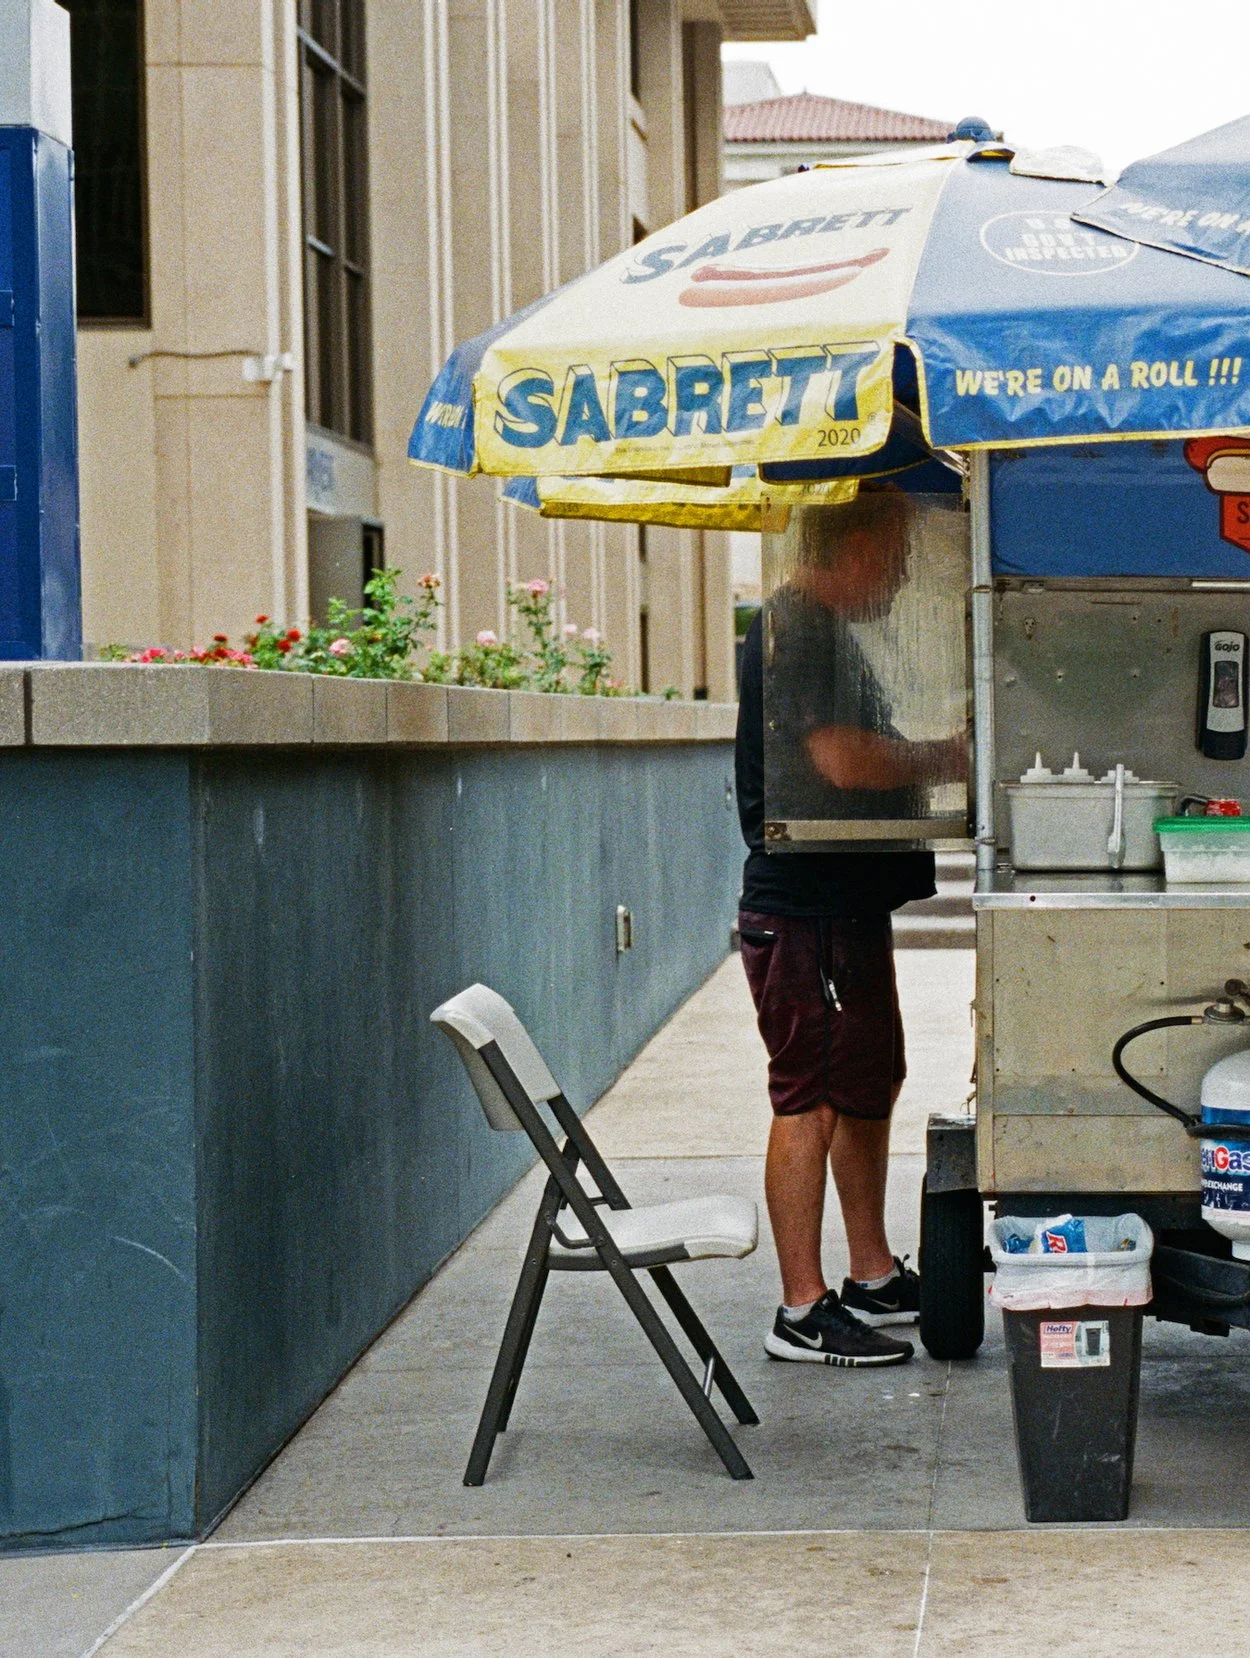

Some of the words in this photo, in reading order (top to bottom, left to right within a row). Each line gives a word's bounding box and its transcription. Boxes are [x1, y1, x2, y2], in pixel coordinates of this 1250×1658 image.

[1198, 212, 1240, 229] ON
[619, 206, 913, 284] SABRETT
[1003, 246, 1129, 261] INSPECTED
[955, 368, 1042, 397] WE'RE
[1053, 365, 1092, 392] ON
[1101, 364, 1121, 391] A
[1131, 360, 1198, 390] ROLL
[494, 340, 881, 448] SABRETT
[817, 428, 861, 447] 2020
[1045, 1325, 1072, 1333] Hefty
